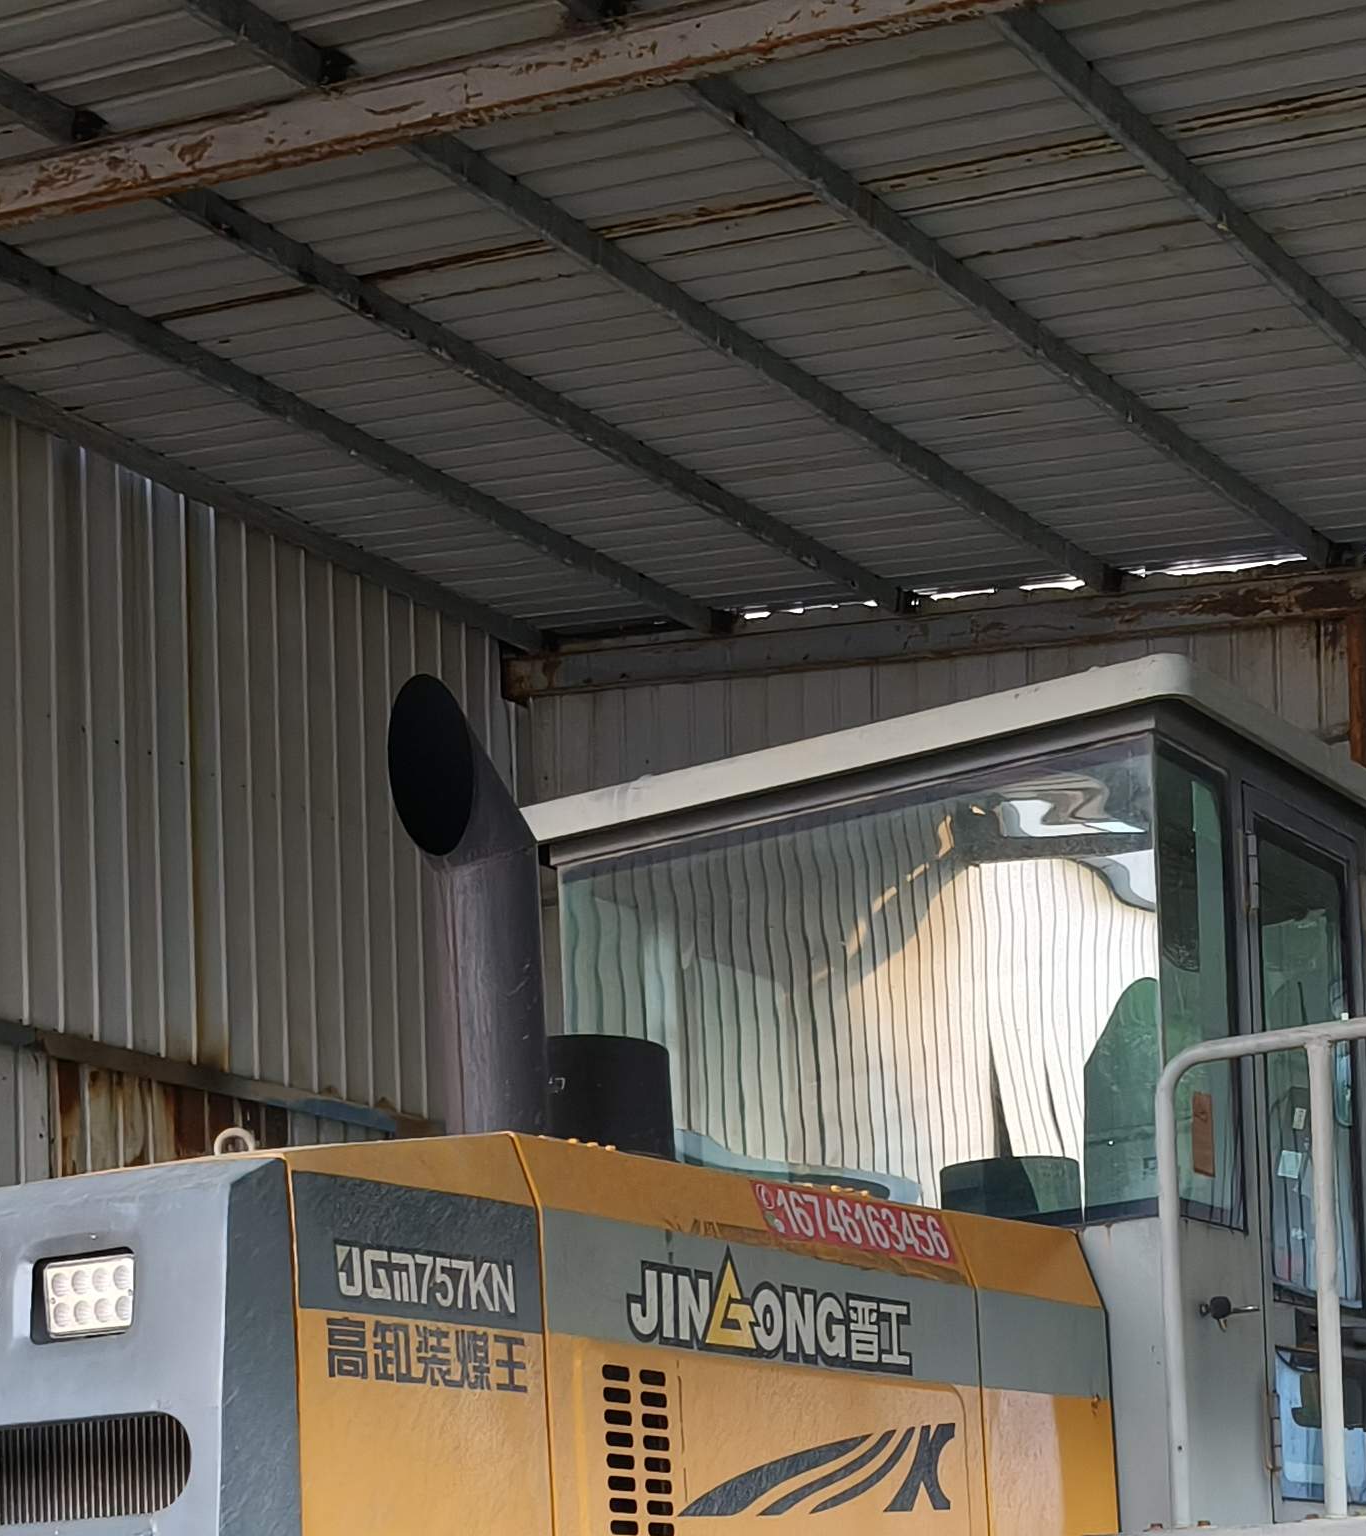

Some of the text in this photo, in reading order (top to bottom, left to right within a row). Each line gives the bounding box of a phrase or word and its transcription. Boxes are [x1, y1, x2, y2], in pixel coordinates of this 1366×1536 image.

[777, 1189, 950, 1260] 16746163456
[326, 1317, 528, 1393] 高卸装煤王
